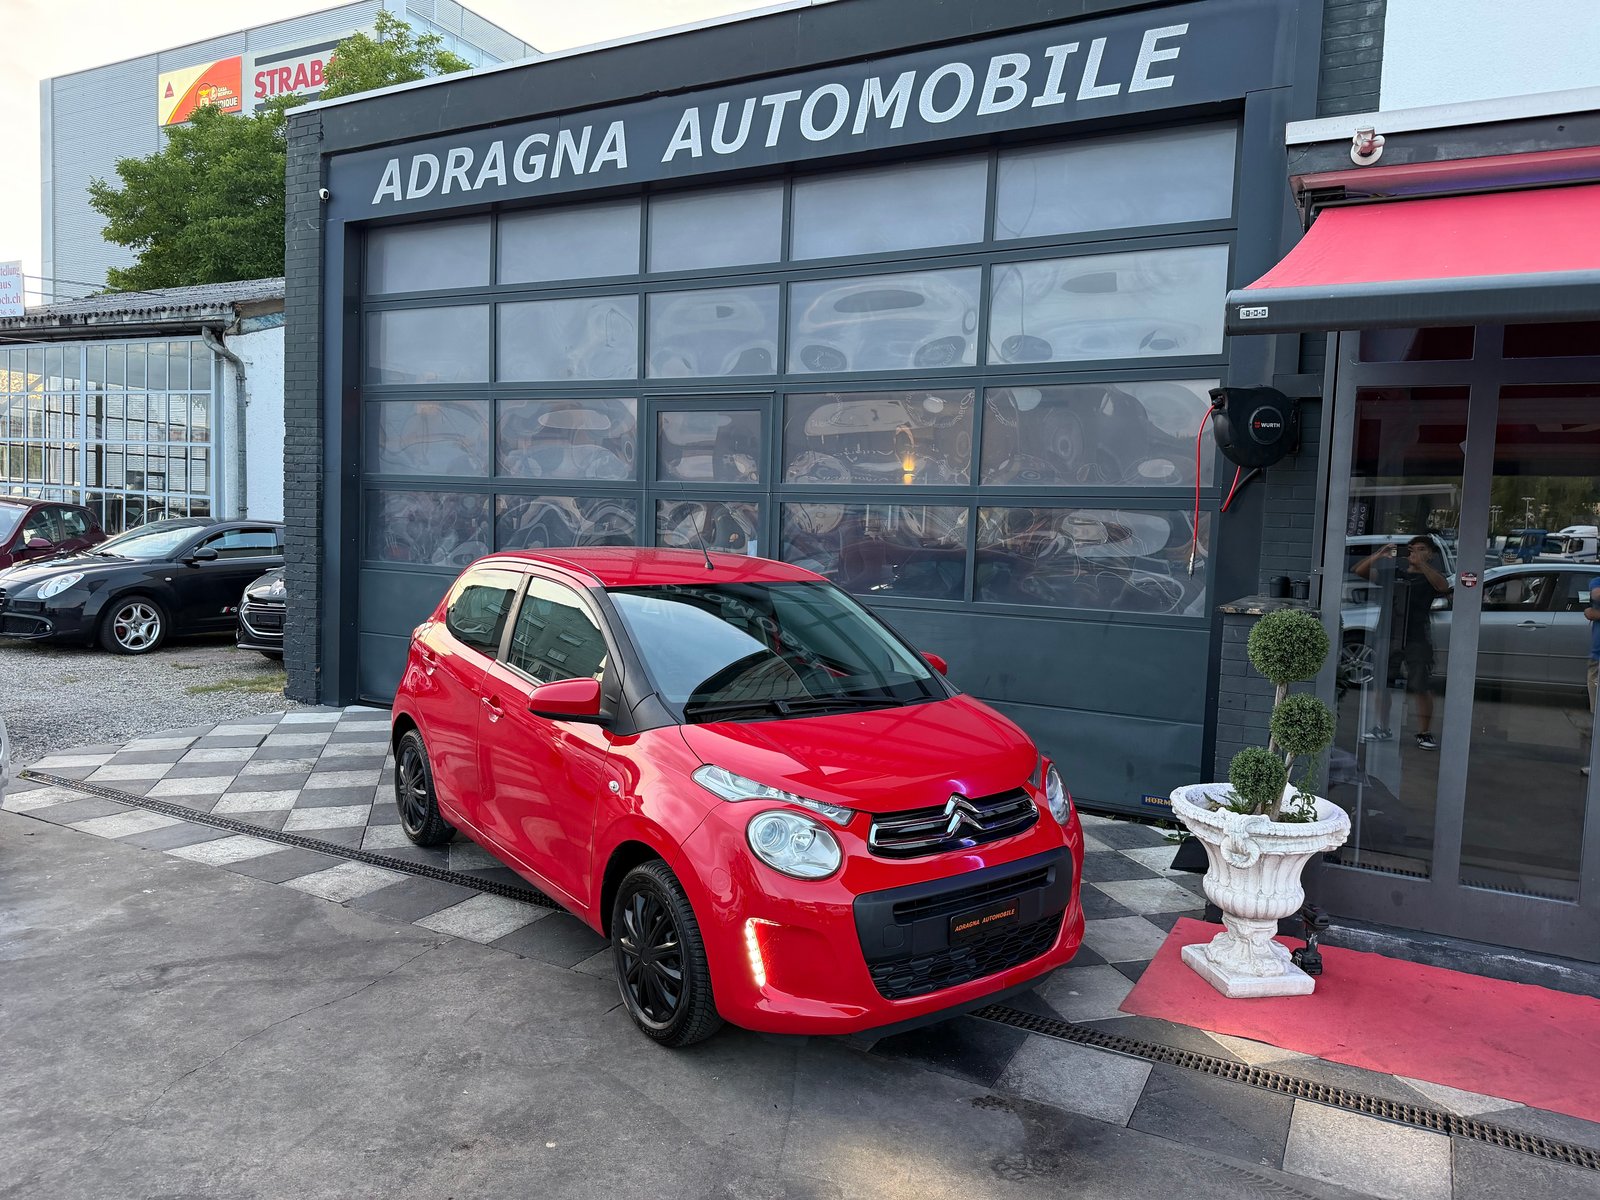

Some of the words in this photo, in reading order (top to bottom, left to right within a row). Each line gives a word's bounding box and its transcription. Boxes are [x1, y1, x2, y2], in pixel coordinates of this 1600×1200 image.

[254, 57, 330, 98] STRAB
[372, 120, 628, 205] ADRAGNA
[661, 22, 1189, 162] AUTOMOBILE
[955, 920, 980, 932] ADRAGNA
[982, 909, 1015, 923] AUTOMOBILE
